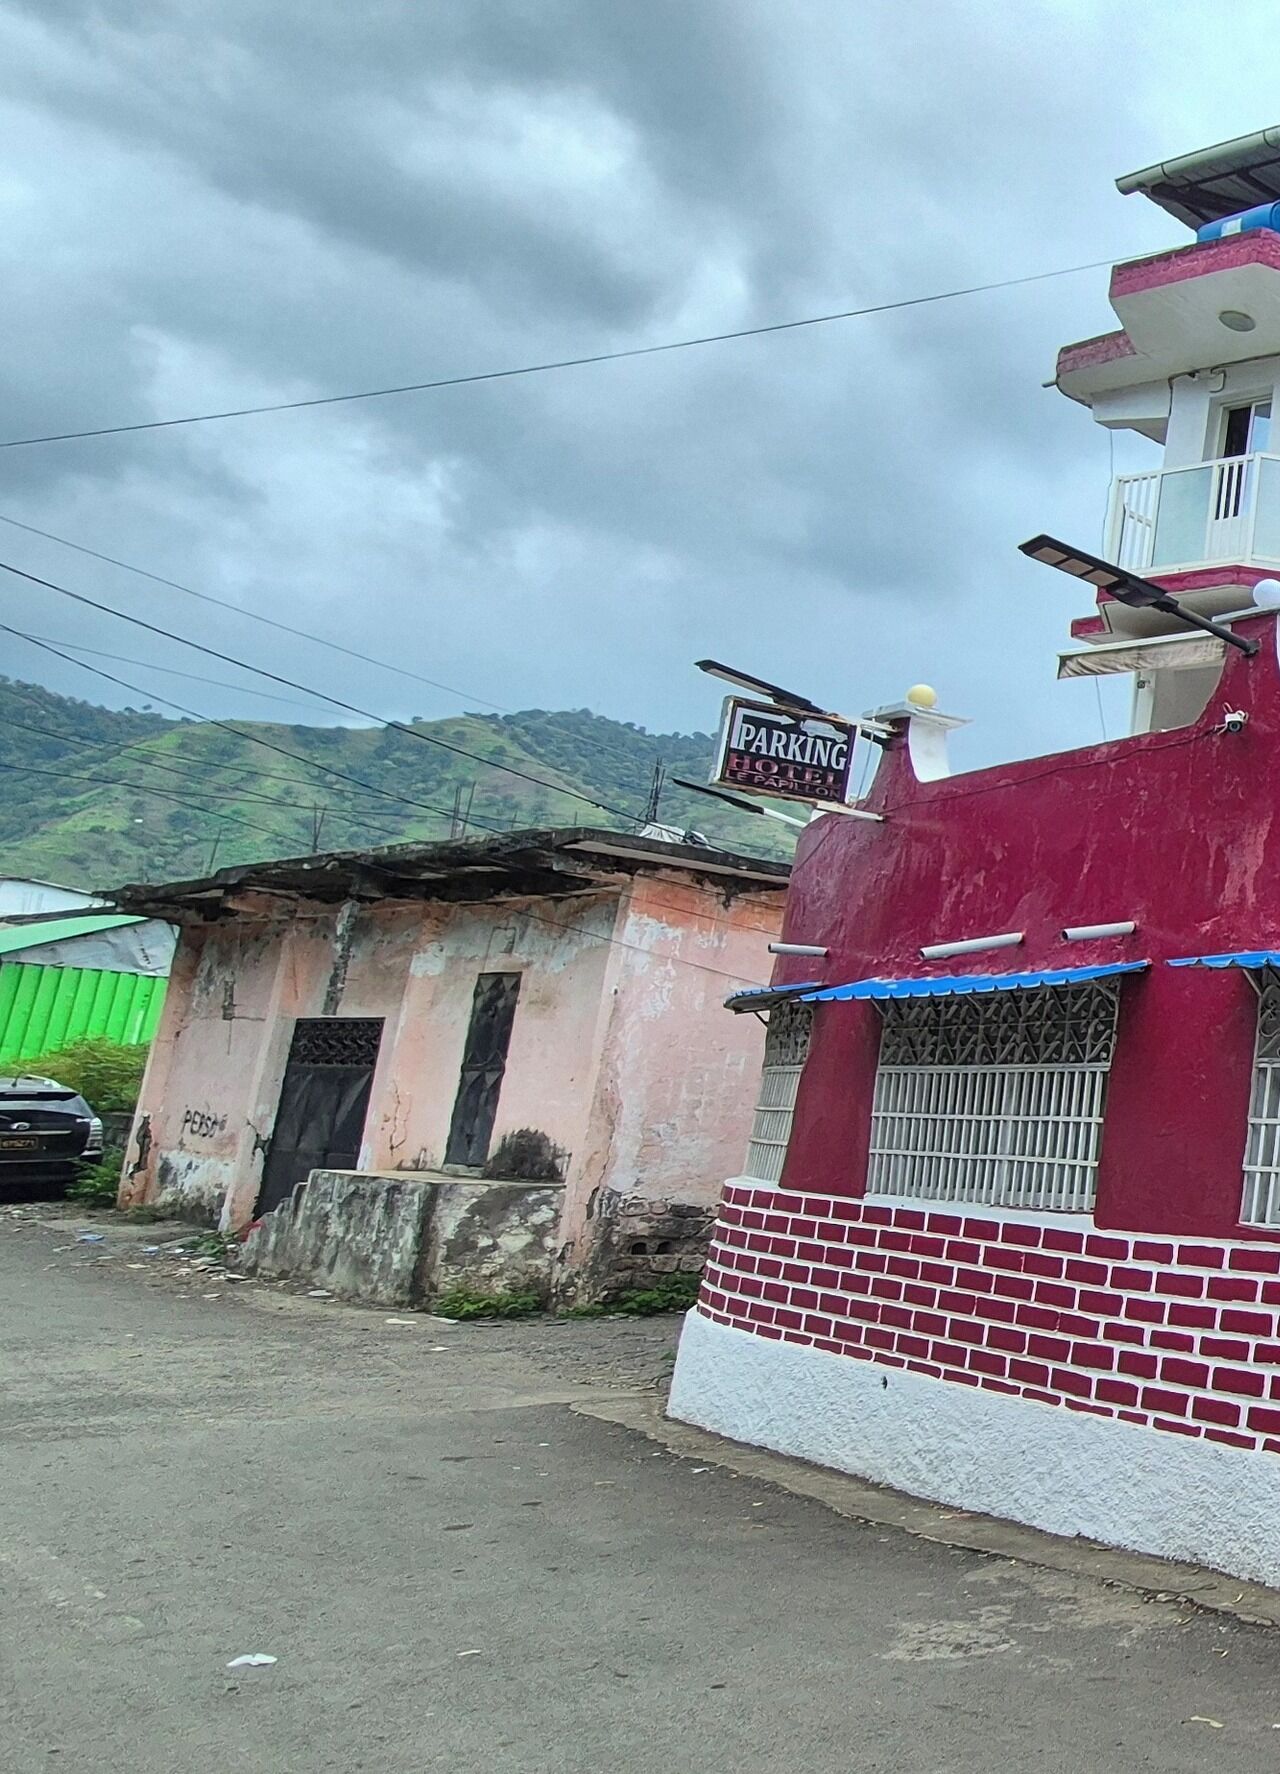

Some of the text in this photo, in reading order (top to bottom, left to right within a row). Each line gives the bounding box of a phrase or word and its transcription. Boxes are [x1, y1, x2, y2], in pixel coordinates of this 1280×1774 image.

[737, 722, 848, 770] PARKING
[725, 769, 841, 798] LE PAPILLON
[728, 752, 842, 789] HOTEL
